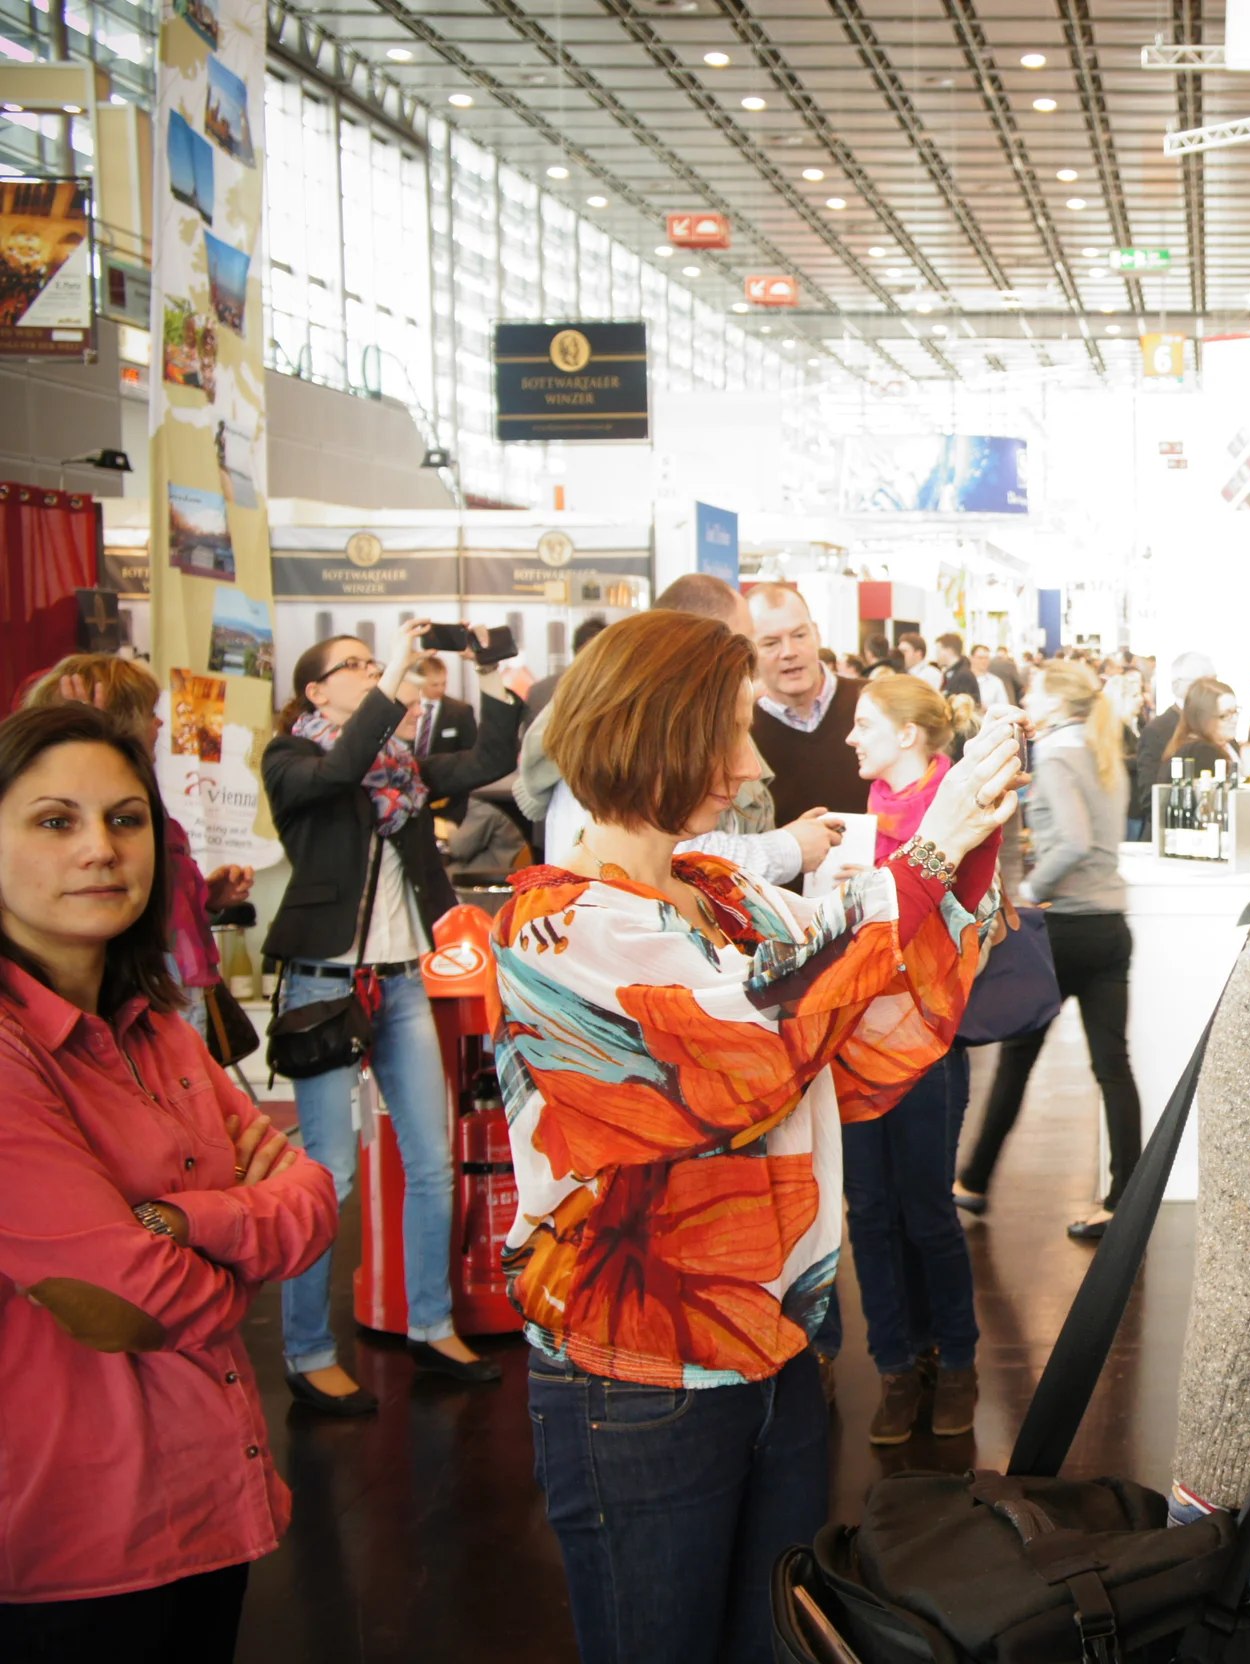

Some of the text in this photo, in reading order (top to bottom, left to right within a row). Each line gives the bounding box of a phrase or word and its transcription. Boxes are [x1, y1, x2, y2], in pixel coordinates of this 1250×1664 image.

[1153, 345, 1172, 374] 6
[544, 392, 595, 405] WINZER
[342, 582, 386, 595] WINZER
